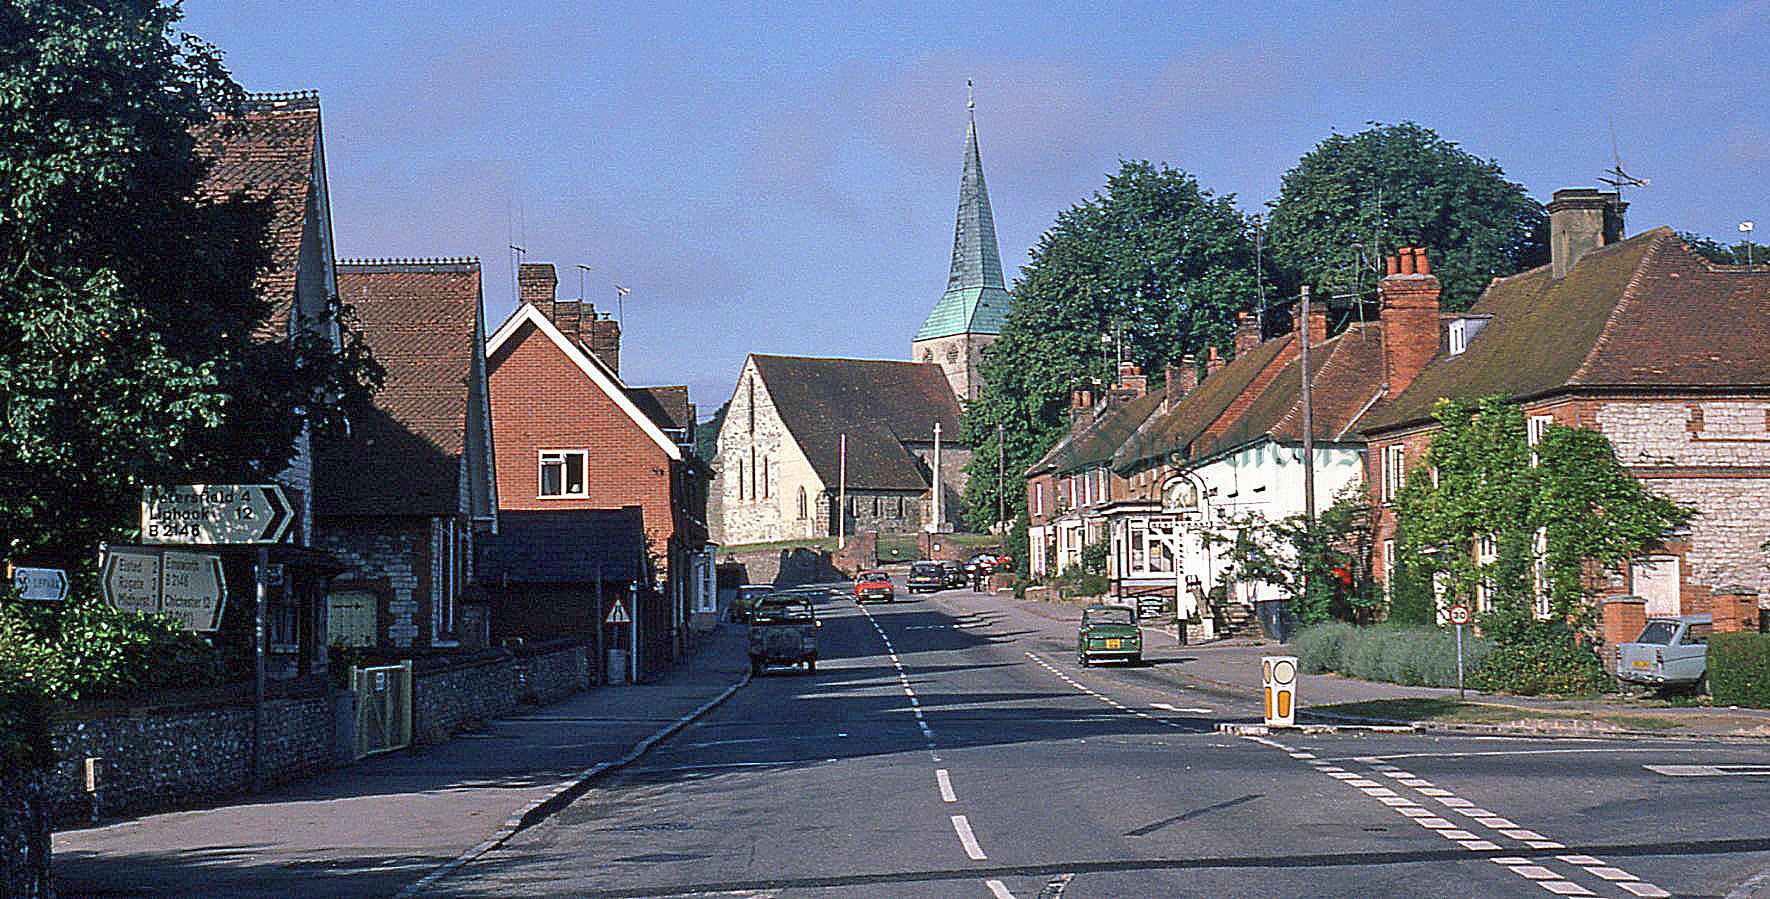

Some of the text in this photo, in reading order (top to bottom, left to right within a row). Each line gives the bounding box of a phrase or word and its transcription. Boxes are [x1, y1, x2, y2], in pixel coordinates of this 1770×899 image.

[241, 490, 251, 502] 4
[236, 506, 254, 520] 12
[1453, 611, 1466, 620] 30
